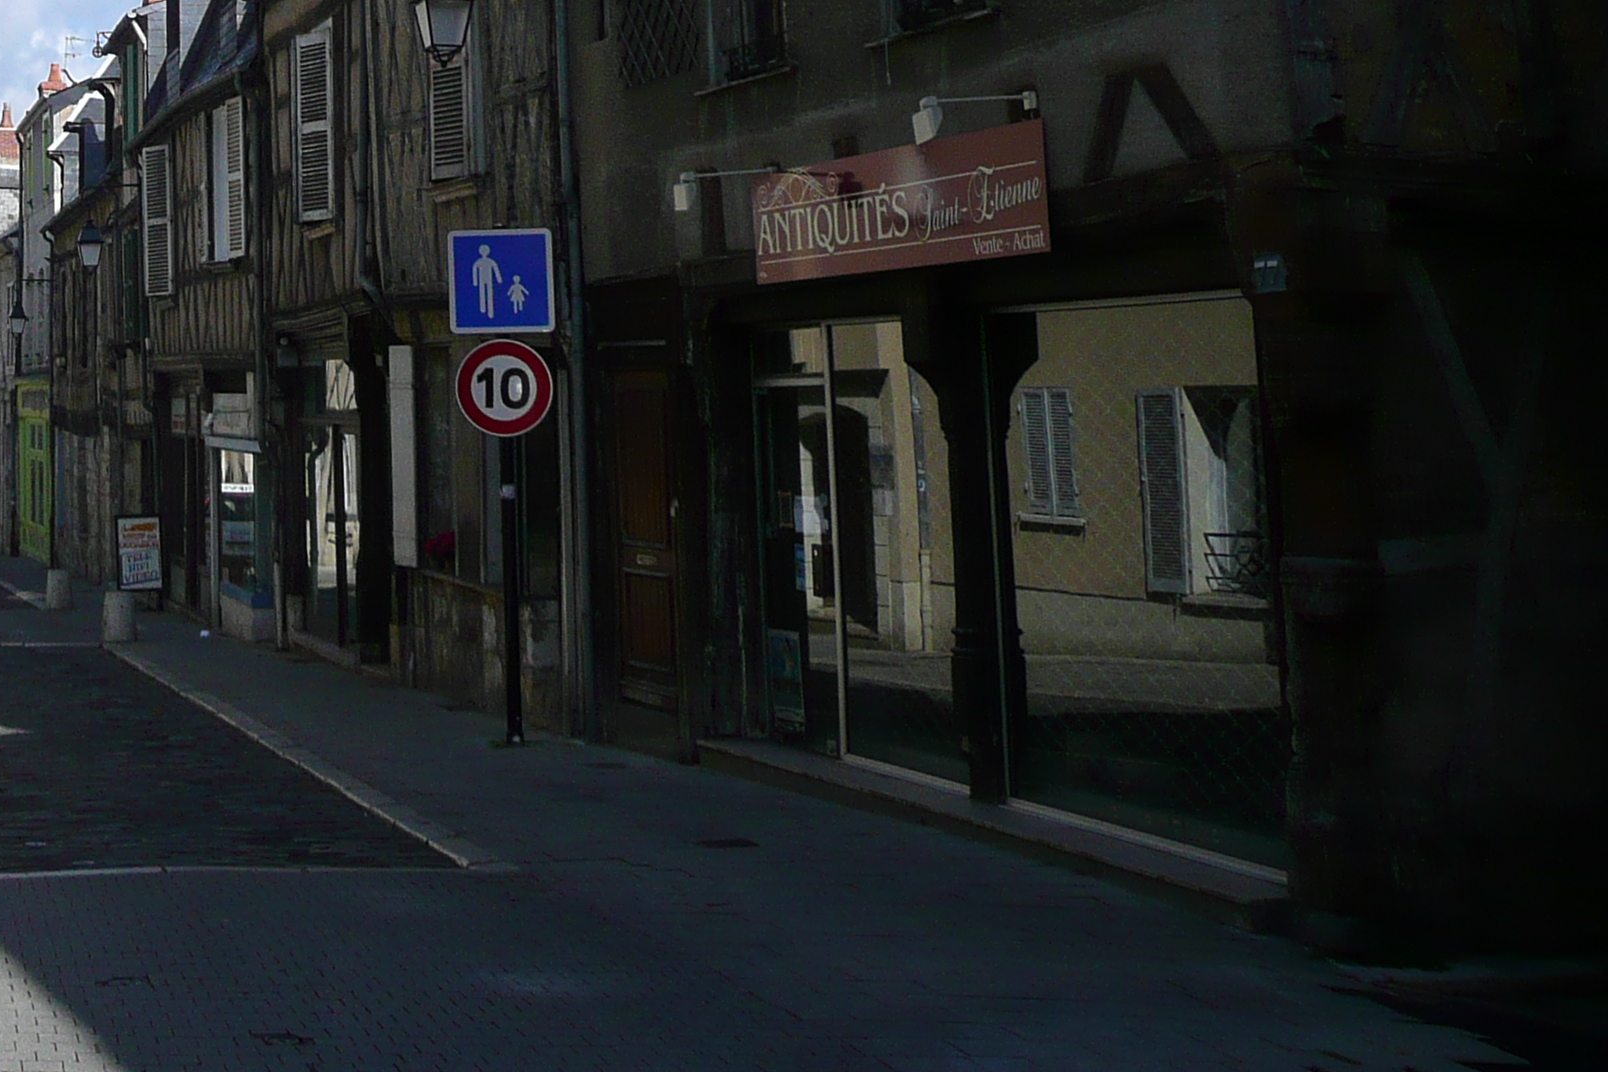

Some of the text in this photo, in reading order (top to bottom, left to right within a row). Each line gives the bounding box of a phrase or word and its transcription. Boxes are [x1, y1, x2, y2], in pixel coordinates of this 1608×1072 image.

[758, 182, 909, 257] ANTIQUITÉS
[972, 237, 1003, 256] Vente
[1012, 230, 1045, 250] Achat
[476, 367, 531, 410] 10
